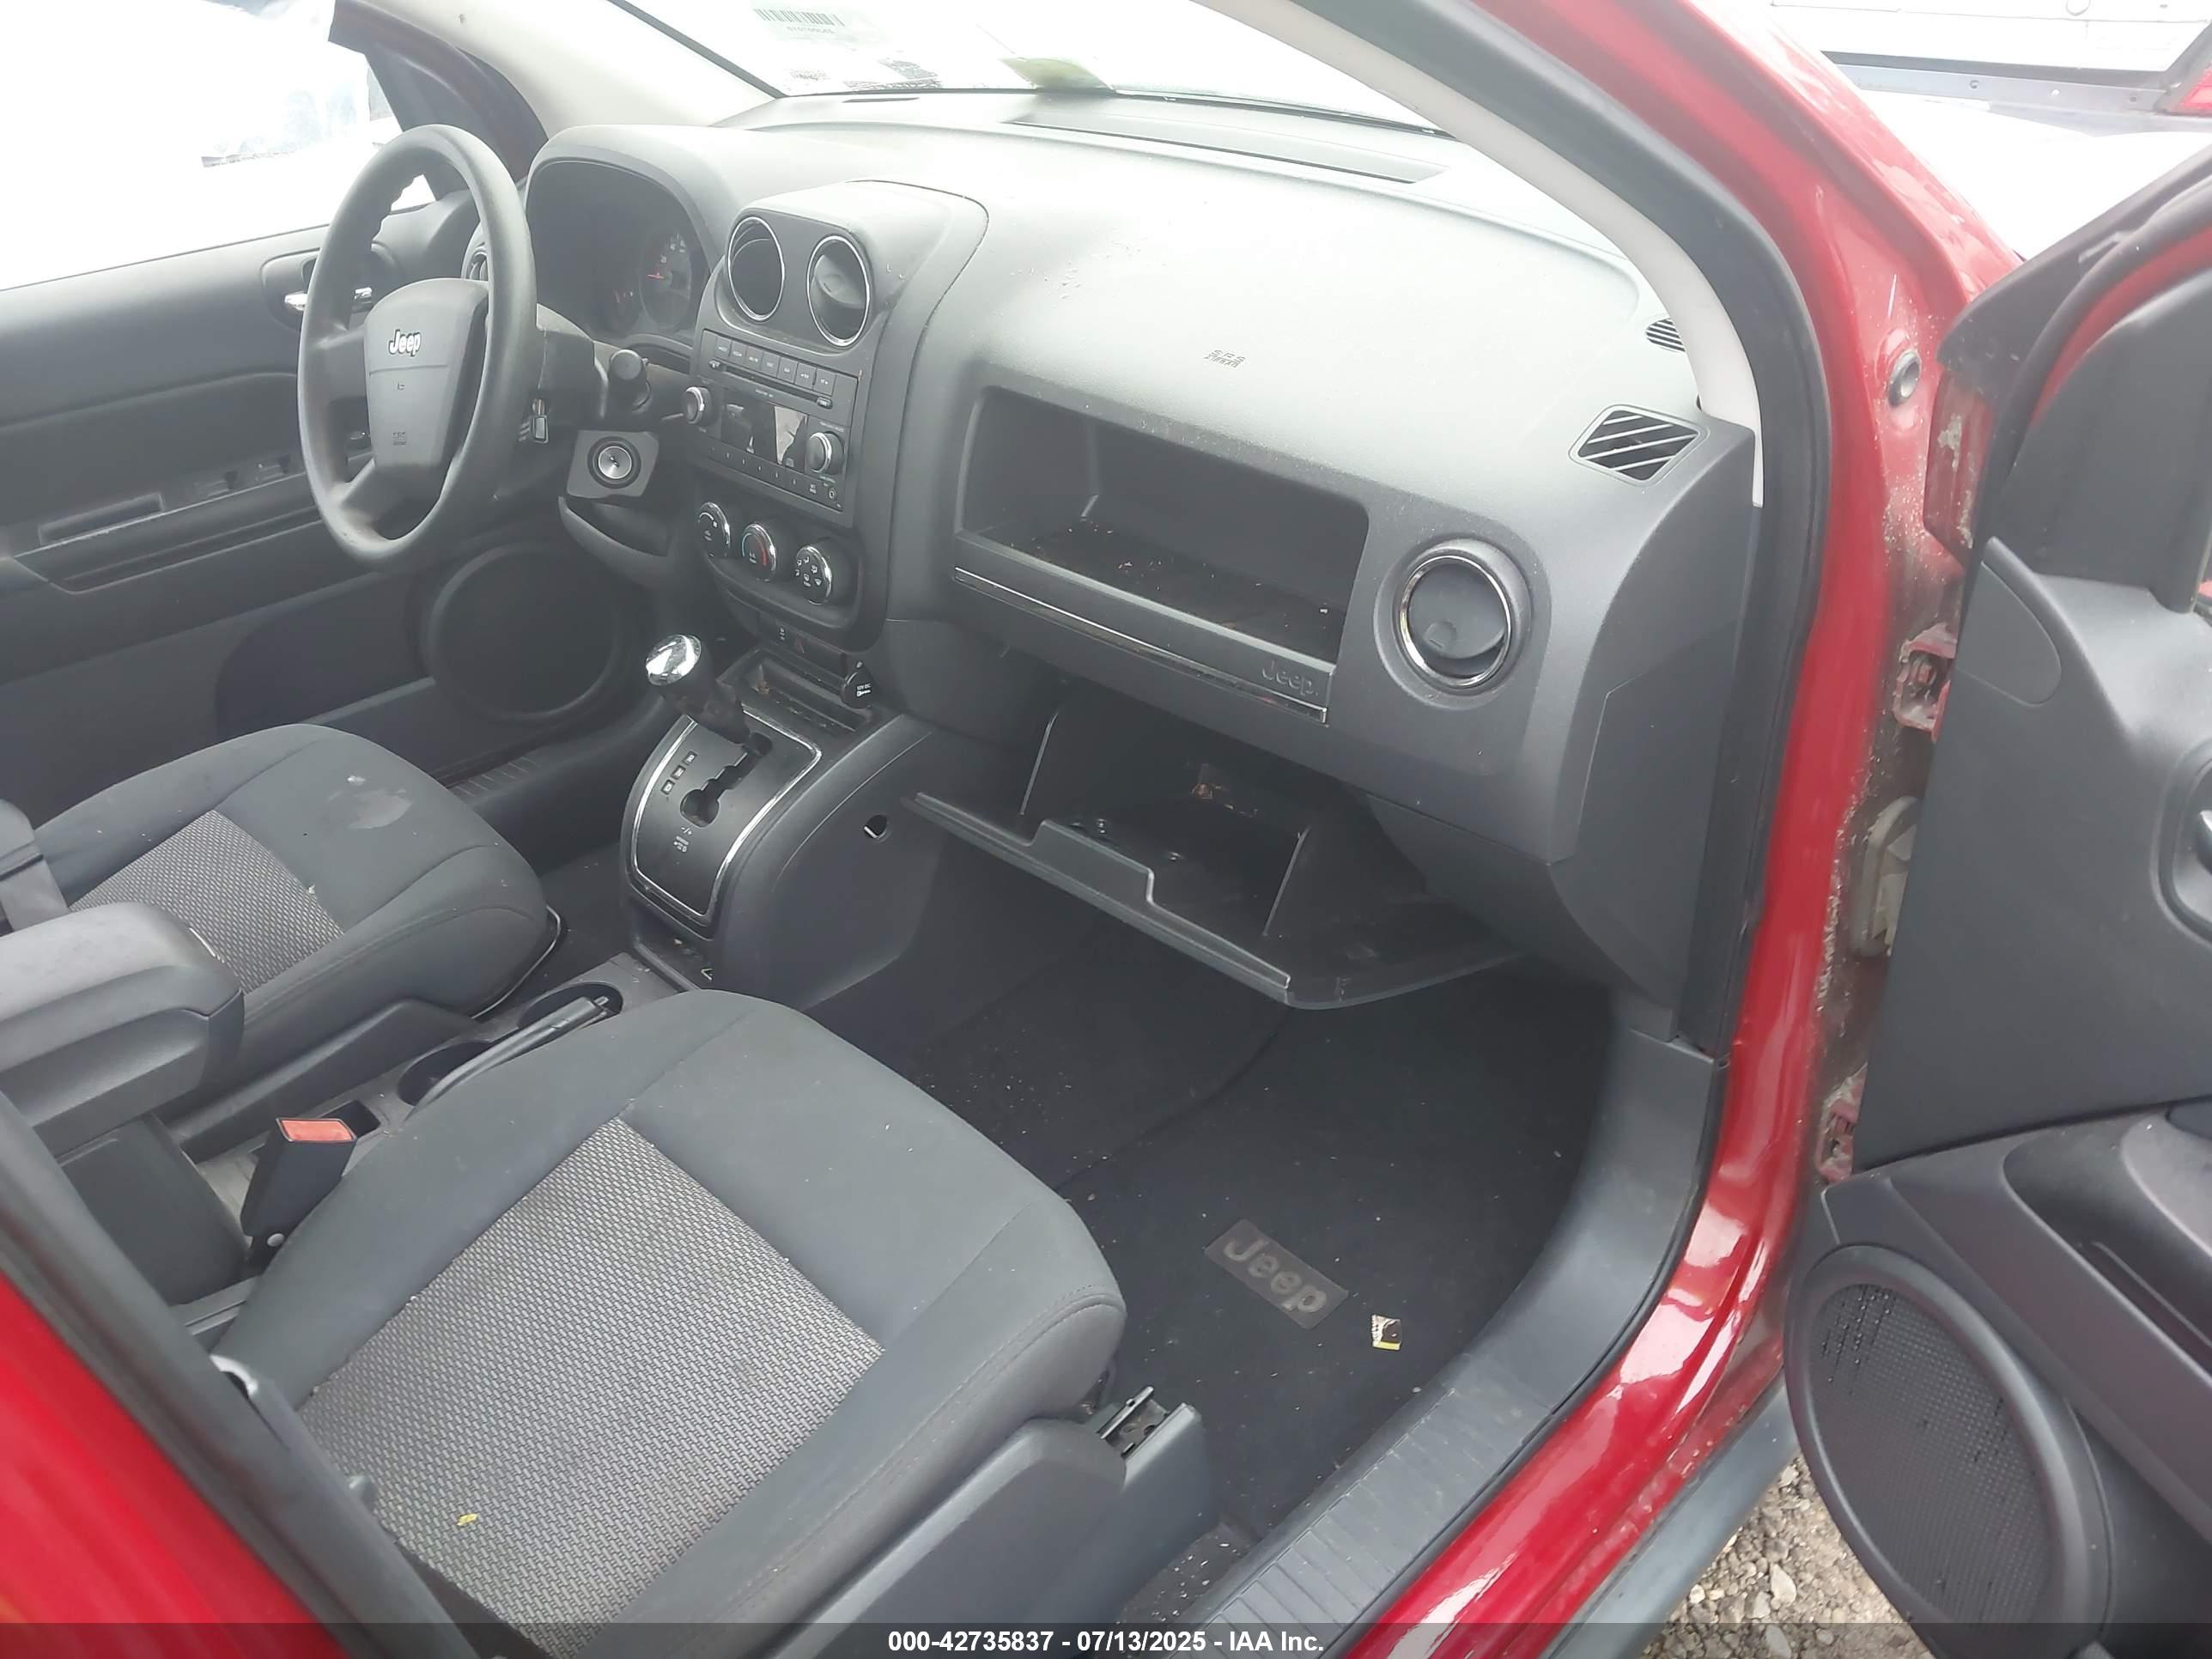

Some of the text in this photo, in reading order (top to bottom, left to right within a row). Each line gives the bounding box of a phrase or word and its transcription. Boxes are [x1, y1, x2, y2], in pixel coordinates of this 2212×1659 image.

[388, 329, 421, 357] Jeep
[1261, 659, 1315, 696] Jeep
[1223, 1238, 1328, 1313] Jeep
